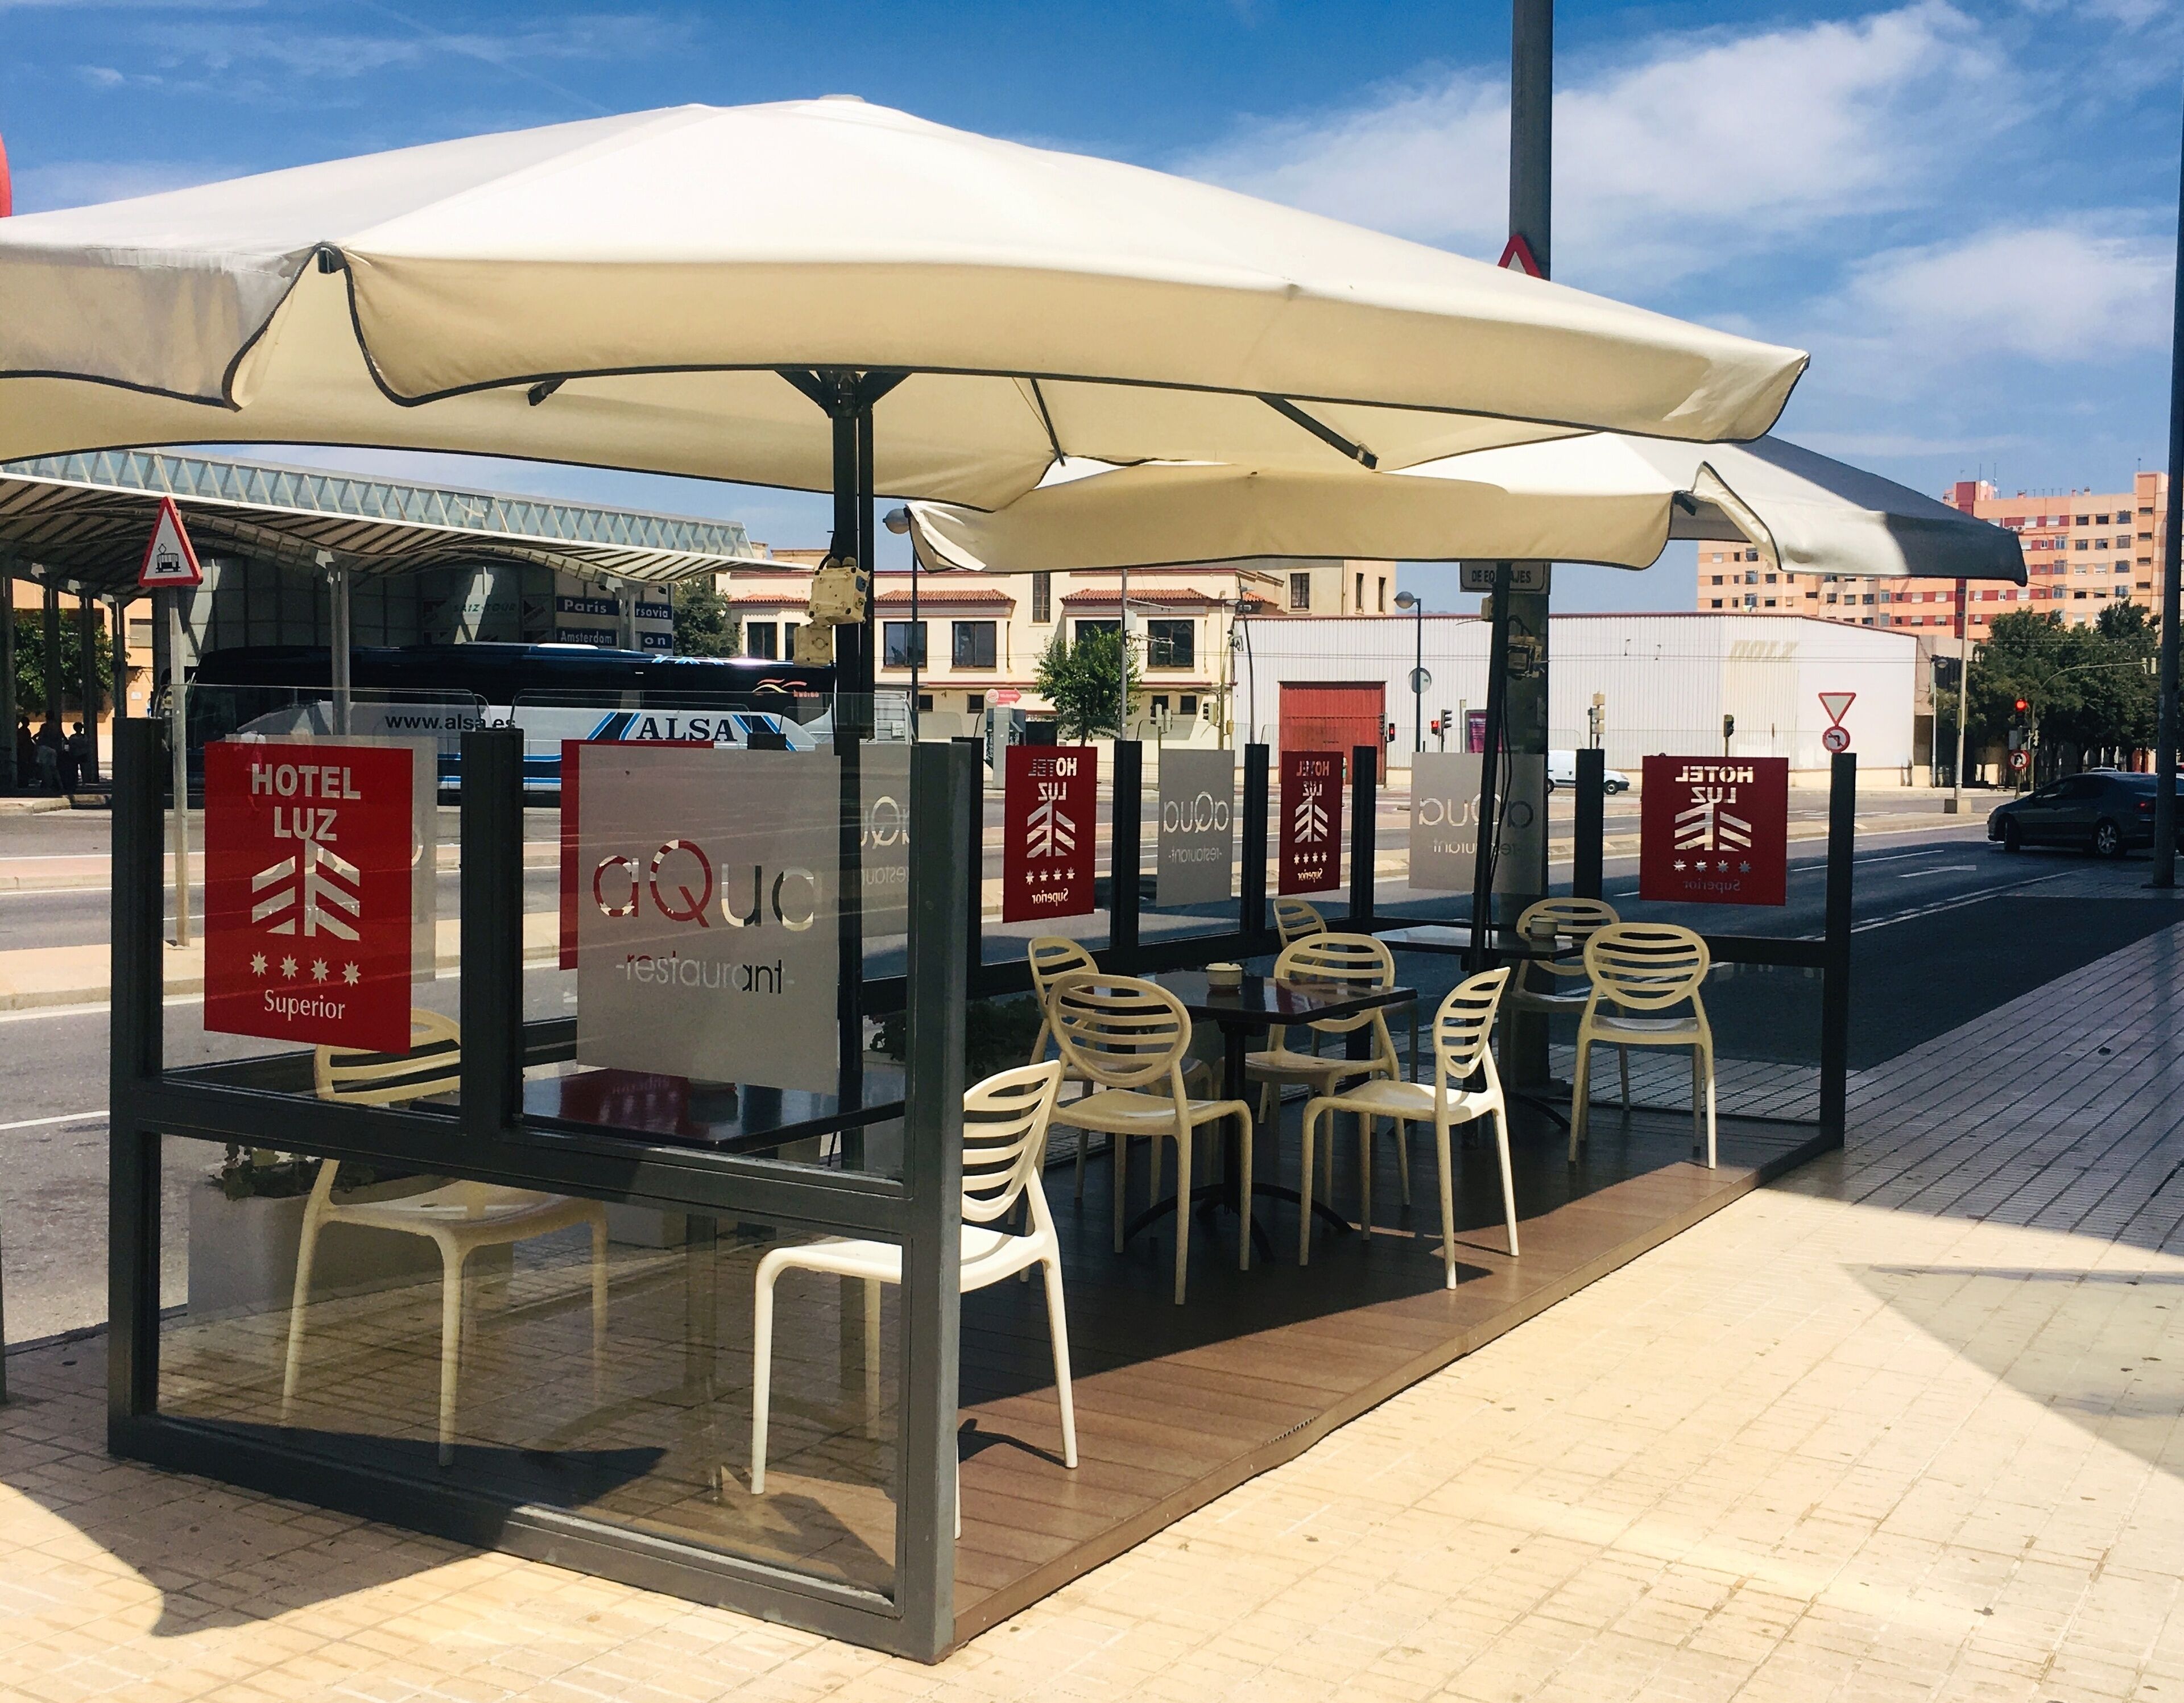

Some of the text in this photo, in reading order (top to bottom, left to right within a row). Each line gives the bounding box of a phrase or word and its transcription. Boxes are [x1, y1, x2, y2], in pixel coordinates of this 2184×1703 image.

[1471, 570, 1482, 582] DE
[561, 630, 612, 644] Amsterdam
[636, 717, 738, 741] ALSA
[251, 763, 361, 800] HOTEL
[274, 807, 337, 841] LUZ
[593, 839, 814, 931] aQua
[264, 989, 345, 1021] Superior
